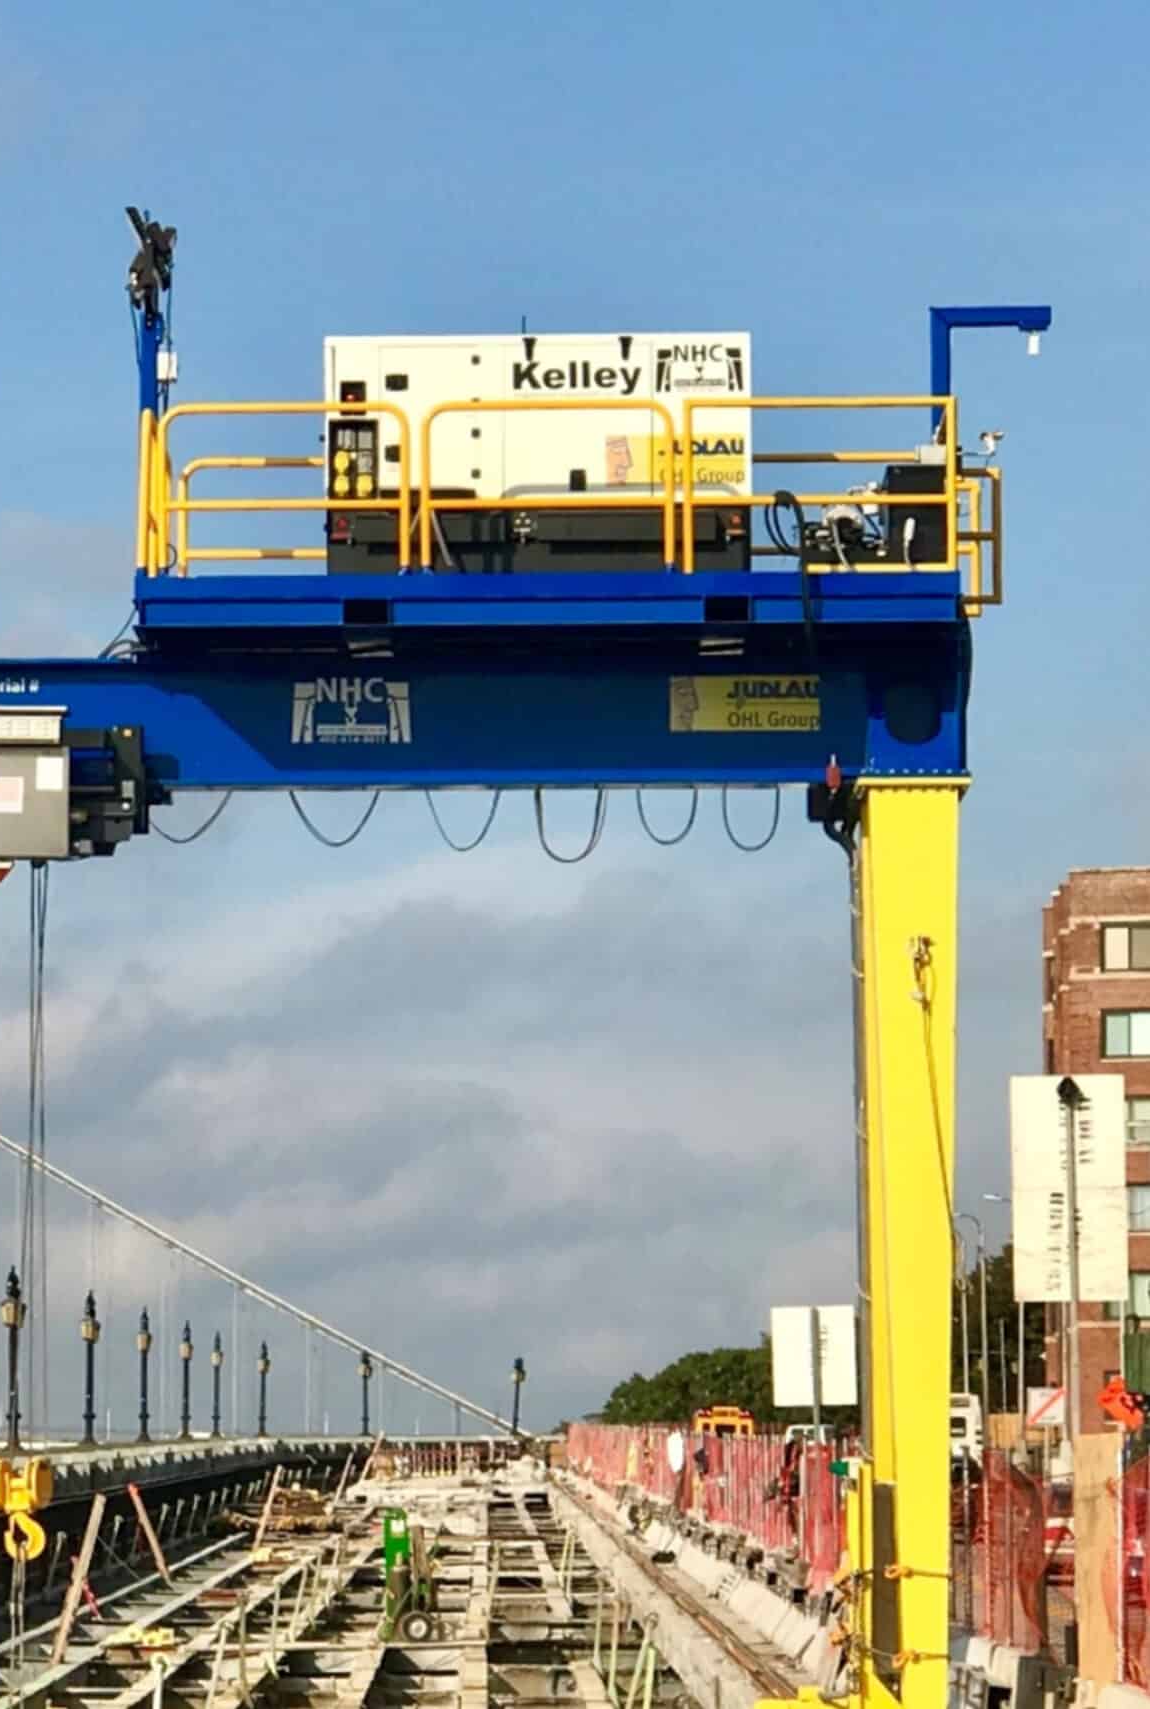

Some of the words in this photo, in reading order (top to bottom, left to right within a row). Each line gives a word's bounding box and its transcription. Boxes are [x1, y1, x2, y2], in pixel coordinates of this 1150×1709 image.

[674, 345, 723, 362] NHC
[513, 361, 641, 395] Kelley
[658, 439, 744, 455] UDLAU
[29, 681, 39, 693] #
[316, 677, 384, 703] NHC
[727, 680, 819, 699] JUDLAU
[727, 711, 762, 728] OHL
[767, 711, 819, 731] Group
